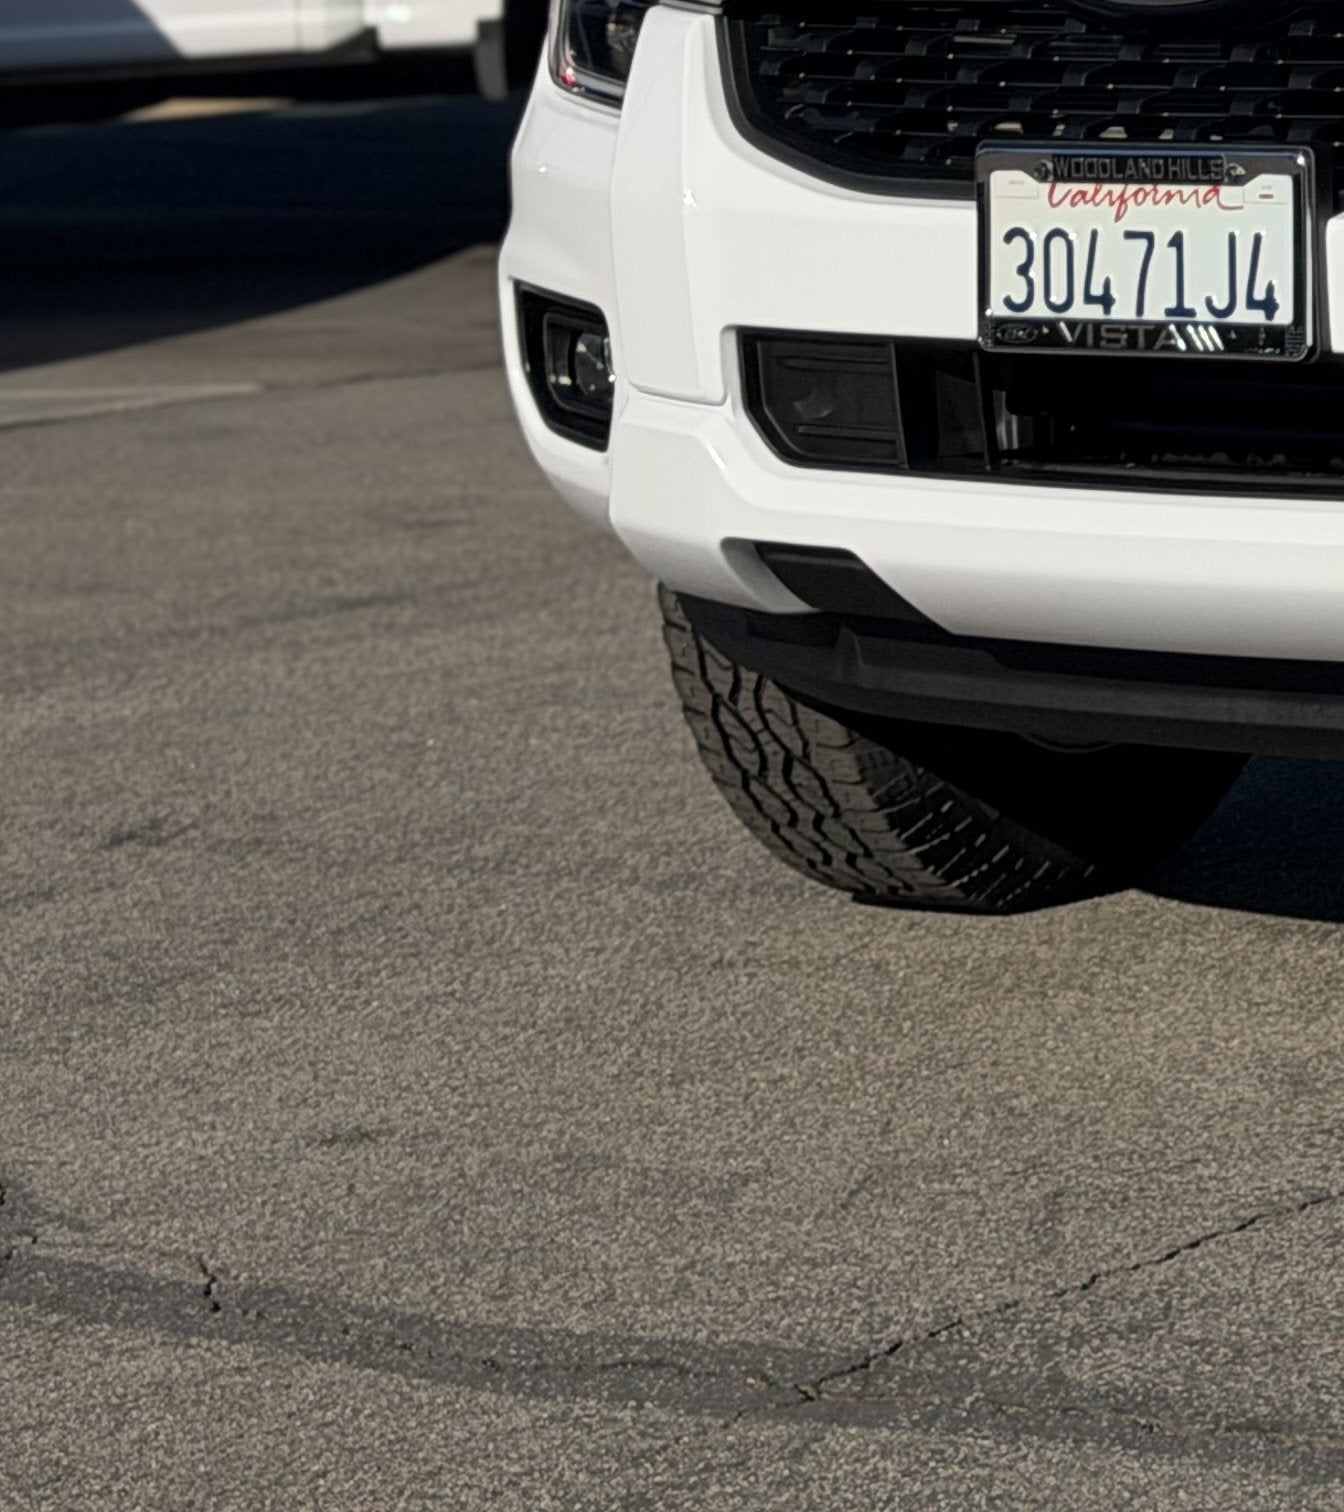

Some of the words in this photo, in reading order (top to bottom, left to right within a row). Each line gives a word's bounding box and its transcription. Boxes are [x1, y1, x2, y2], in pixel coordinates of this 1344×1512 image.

[1053, 156, 1165, 180] WOODLAND
[1168, 158, 1224, 181] HILLS
[1047, 182, 1244, 223] California
[1003, 226, 1280, 321] 30471J4
[1059, 321, 1187, 352] VISTA
